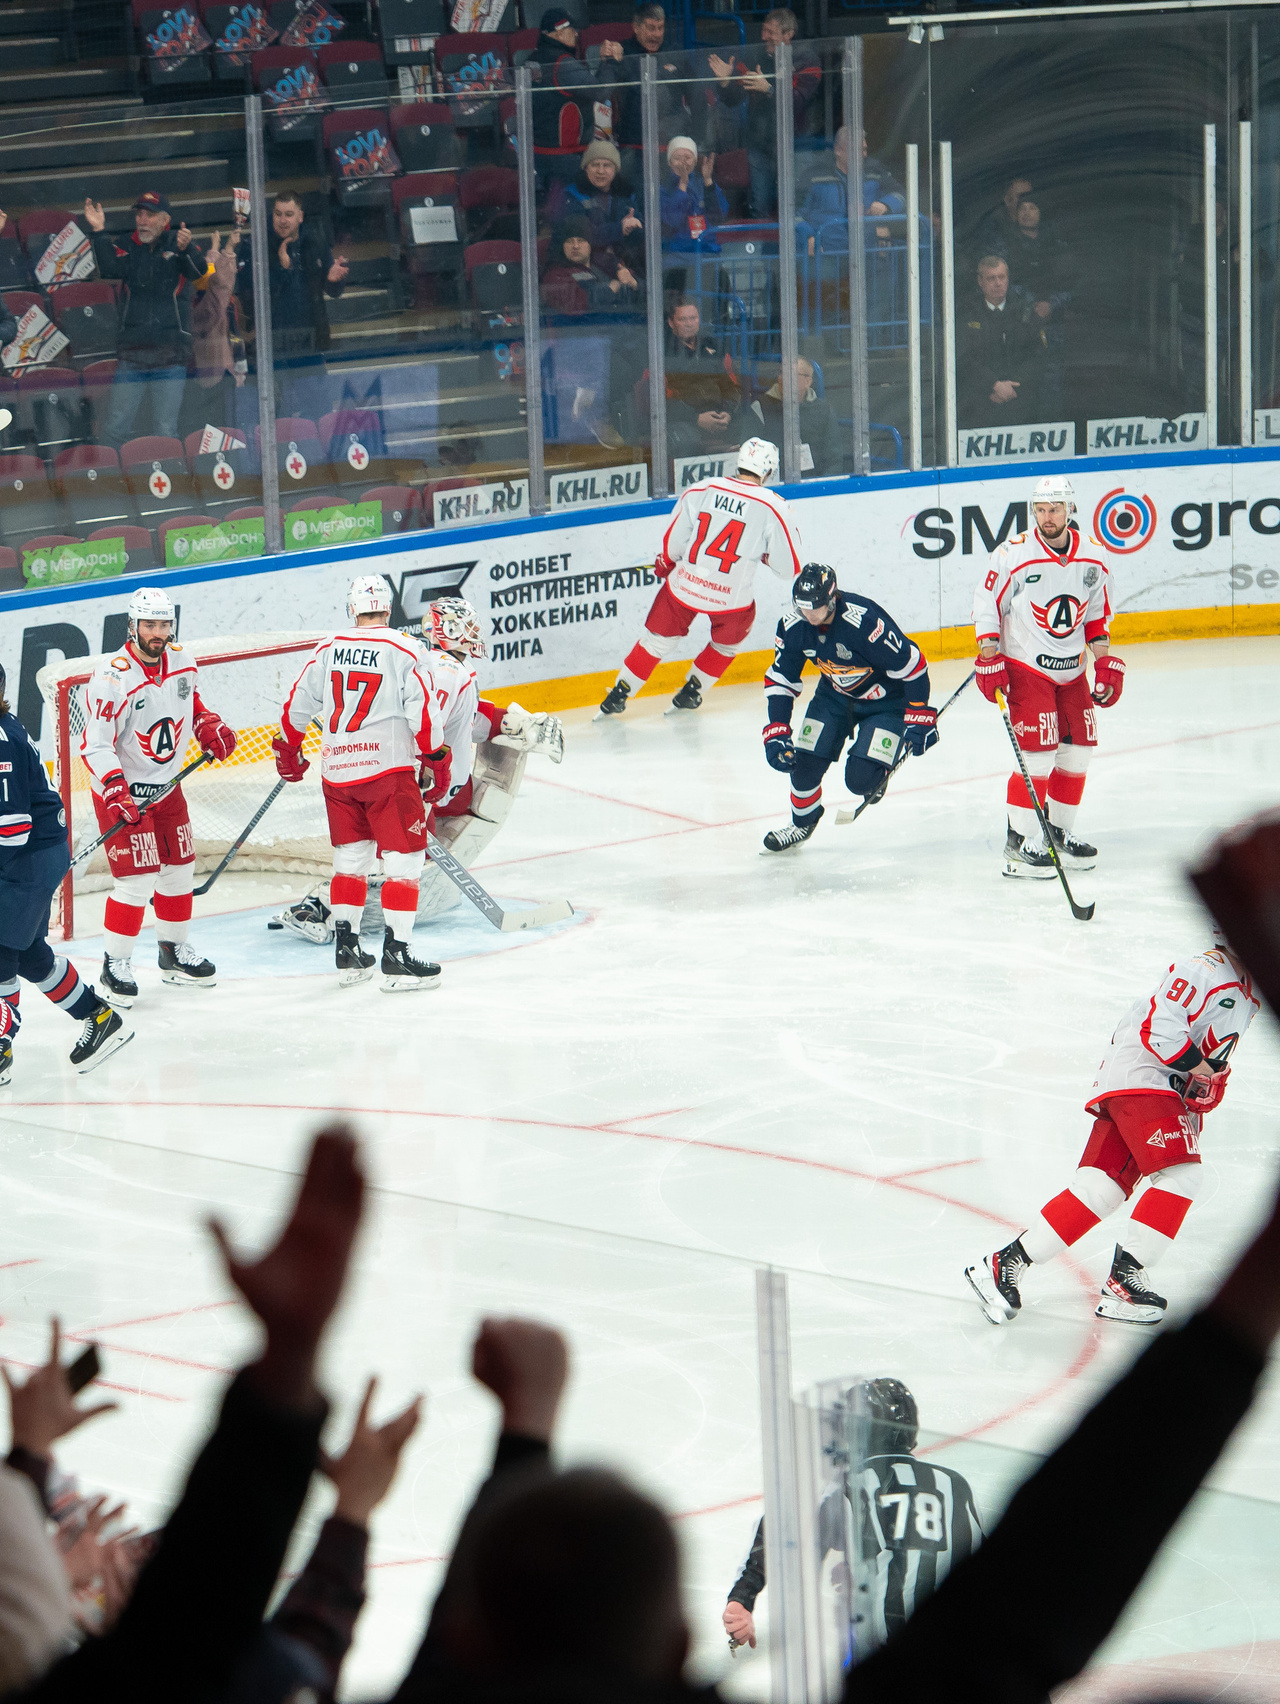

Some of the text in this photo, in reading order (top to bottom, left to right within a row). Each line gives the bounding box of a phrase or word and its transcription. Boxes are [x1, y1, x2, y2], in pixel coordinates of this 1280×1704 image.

[35, 227, 75, 274] METALLURG
[965, 429, 1068, 458] KHL.RU
[1096, 420, 1200, 449] KHL.RU
[556, 470, 641, 504] KHL.RU
[439, 486, 523, 522] KHL.RU
[714, 494, 747, 517] VALK
[688, 511, 747, 574] 14
[489, 553, 572, 582] ФОНБЕТ
[984, 570, 999, 592] 8
[490, 566, 663, 609] КОНТИНЕНТАЛЬ
[370, 600, 379, 611] 17
[490, 599, 618, 636] ХОККЕЙНАЯ
[490, 637, 544, 663] ЛИГА
[883, 630, 903, 654] 12
[333, 648, 381, 668] MACEK
[330, 670, 383, 734] 17
[331, 742, 380, 756] АЗПРОМБАНК
[1165, 976, 1198, 1010] 91
[879, 1492, 944, 1543] 78
